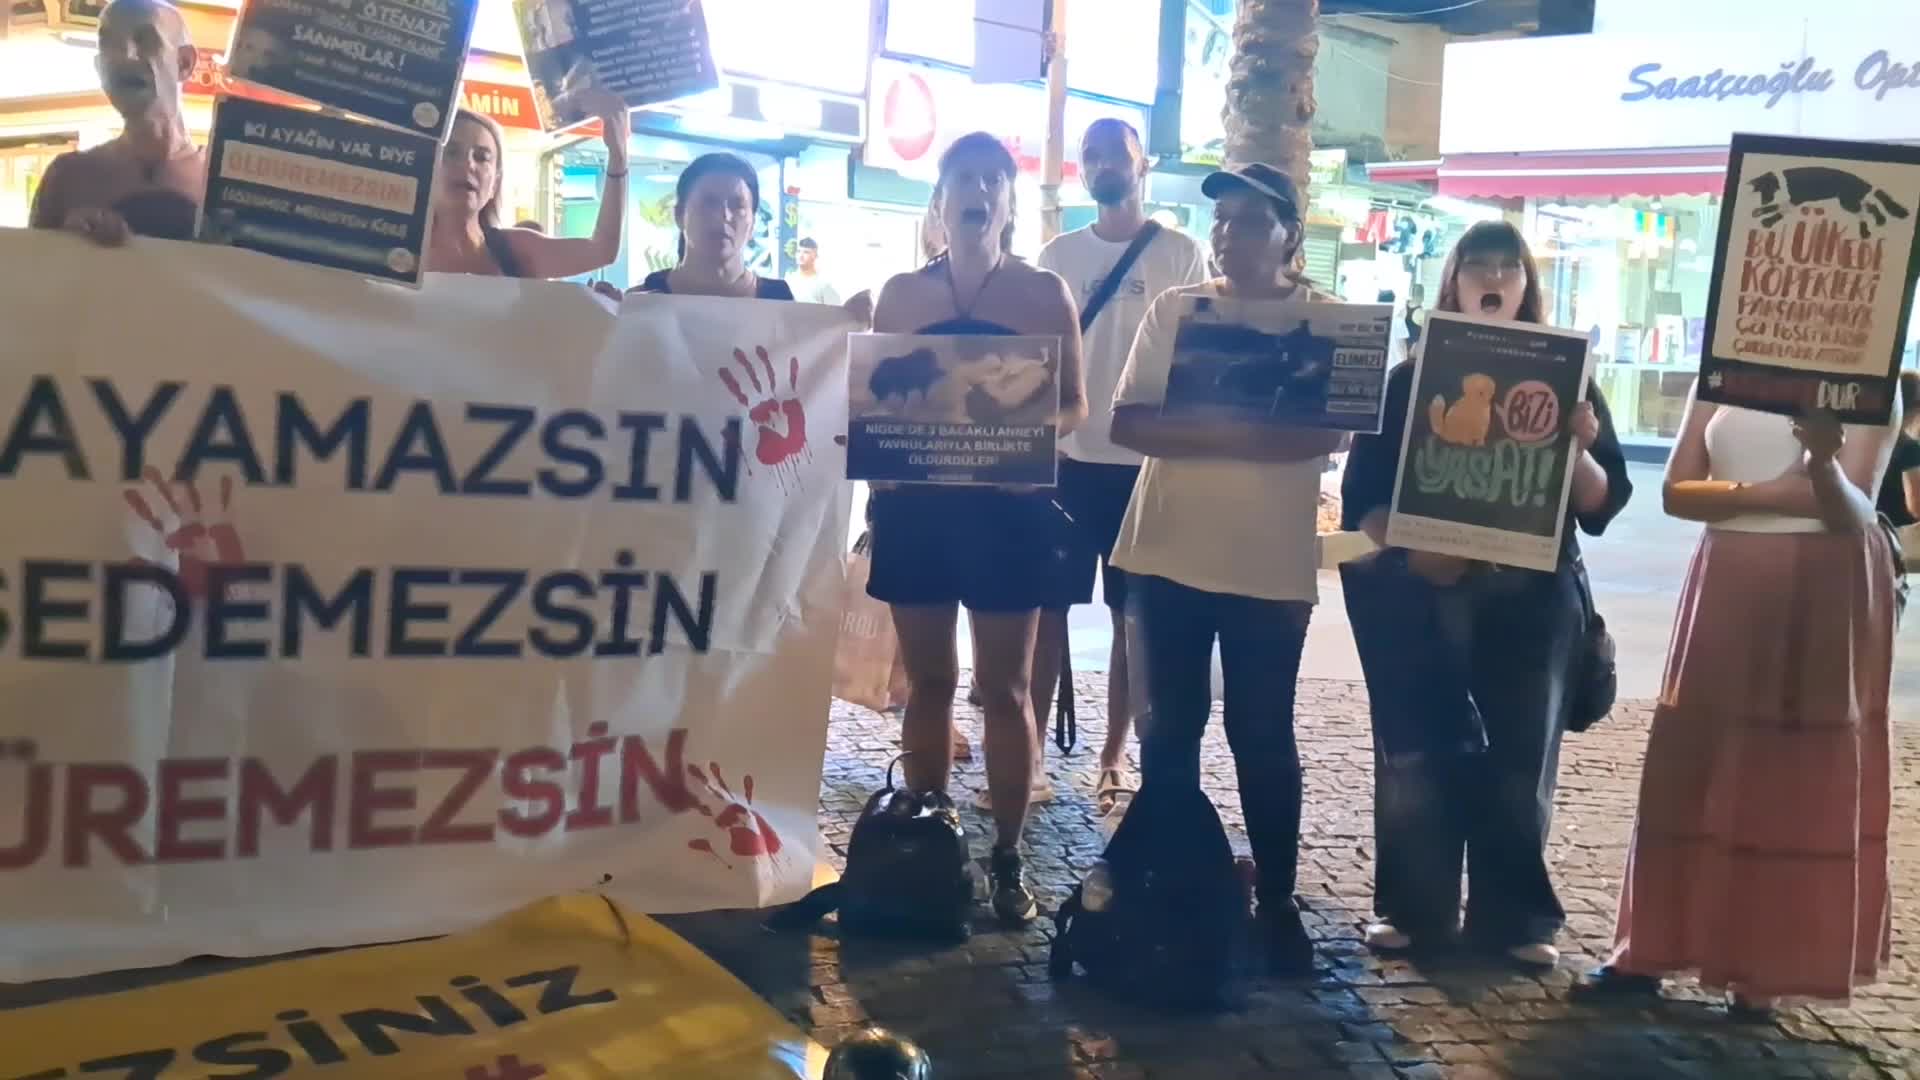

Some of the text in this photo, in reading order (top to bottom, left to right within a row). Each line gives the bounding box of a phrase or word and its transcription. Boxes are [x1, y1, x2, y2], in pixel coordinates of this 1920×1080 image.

[1620, 57, 1834, 109] Saatçıoğlu
[341, 141, 373, 158] VAR
[0, 374, 743, 504] AYAMAZSIN
[0, 550, 718, 662] EDEMEZSİN
